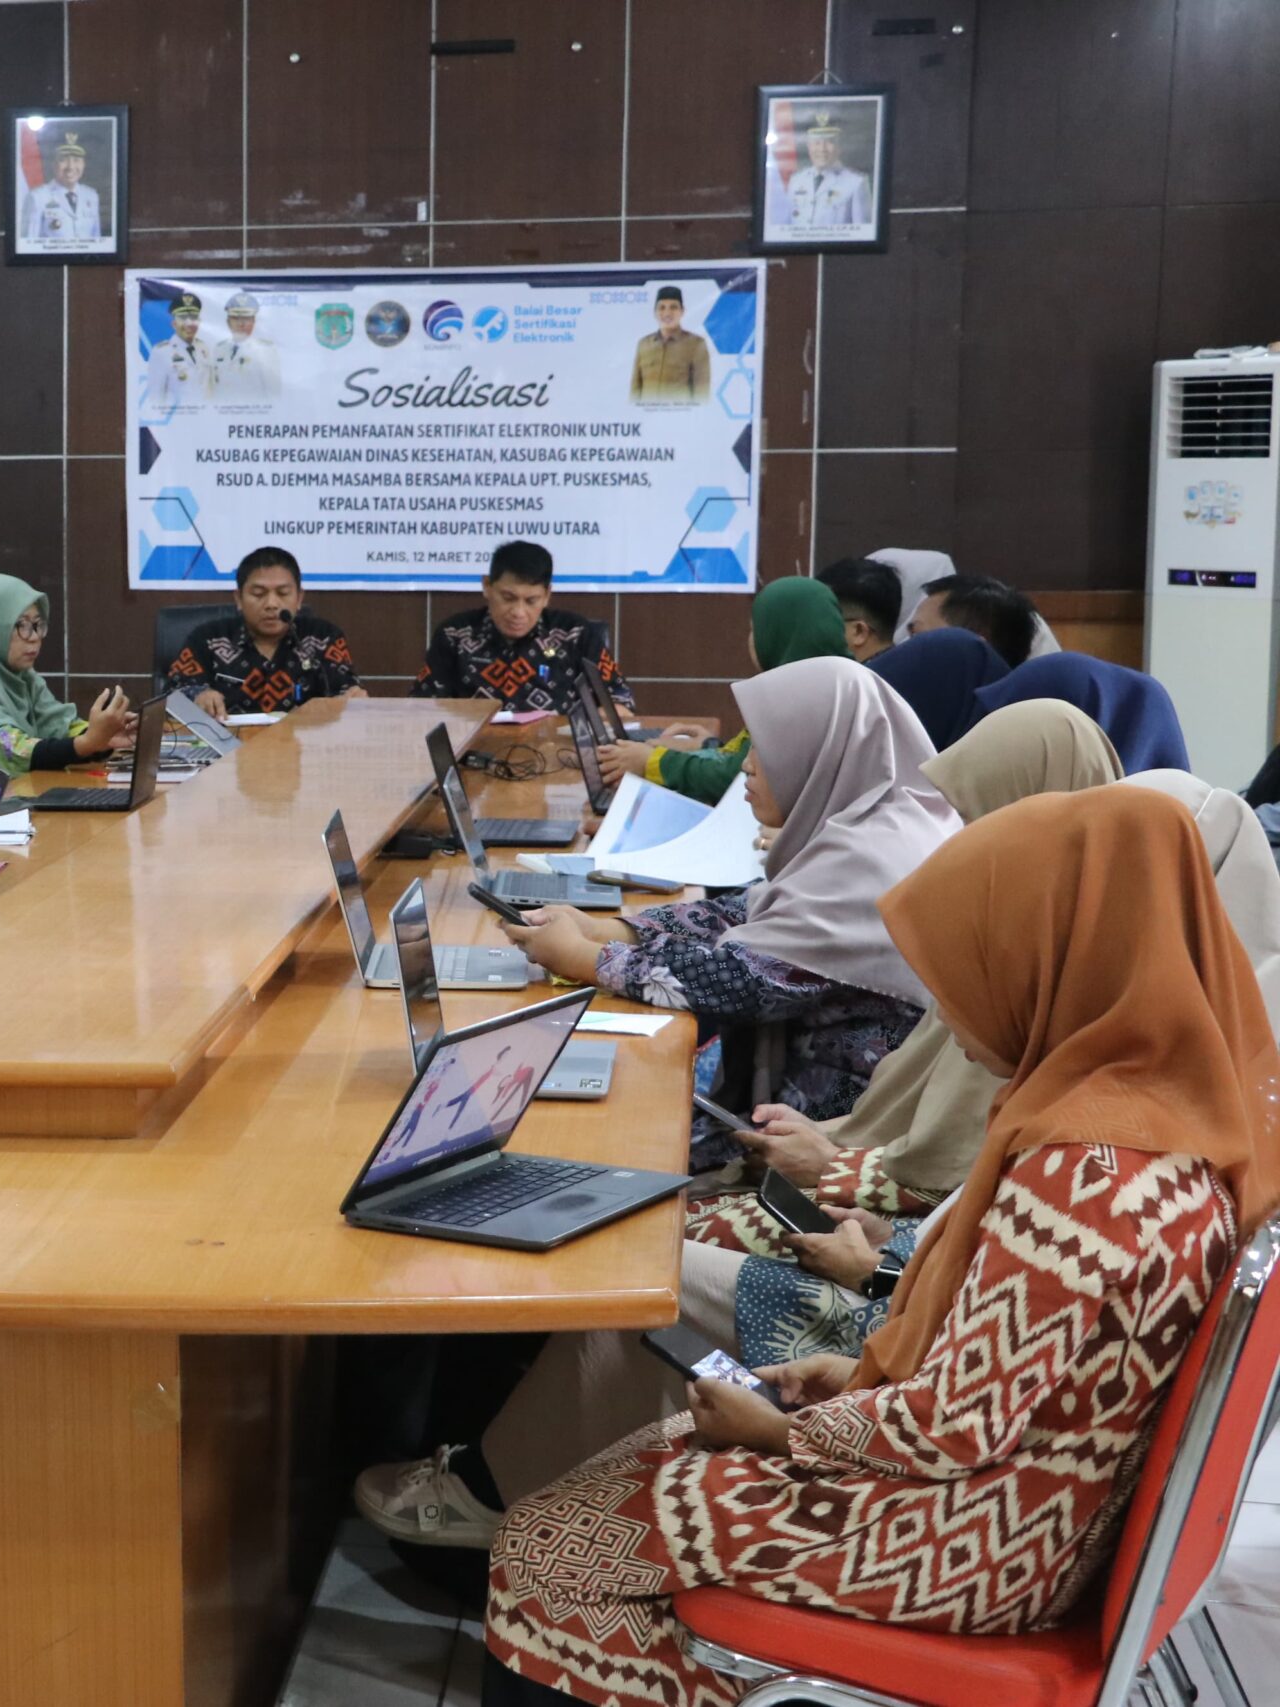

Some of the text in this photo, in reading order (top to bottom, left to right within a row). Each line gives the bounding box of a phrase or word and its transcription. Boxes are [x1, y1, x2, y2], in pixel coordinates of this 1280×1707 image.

[514, 304, 582, 316] Balai Besar
[514, 319, 577, 330] Sertifikasi
[513, 332, 575, 344] Elektronik
[337, 365, 555, 408] Sosialisasi
[228, 422, 642, 439] PENERAPAN PEMANFAATAN SERTIFIKAT ELEKTRONIK UNTUK
[196, 447, 675, 464] KASUBAG KEPEGAWAIAN DINAS KESEHATAN, KASUBAG KEPEGAWAIAN
[216, 472, 652, 488] RSUD A. DJEMMA MASAMBA BERSAMA KEPALA UPT. PUSKESMAS,
[319, 497, 544, 511] KEPALA TATA USAHA PUSKESMAS
[264, 521, 600, 536] LINGKUP PEMERINTAH KABUPATEN LUWU UTARA
[366, 552, 493, 564] KAMIS, 12 MARET 20
